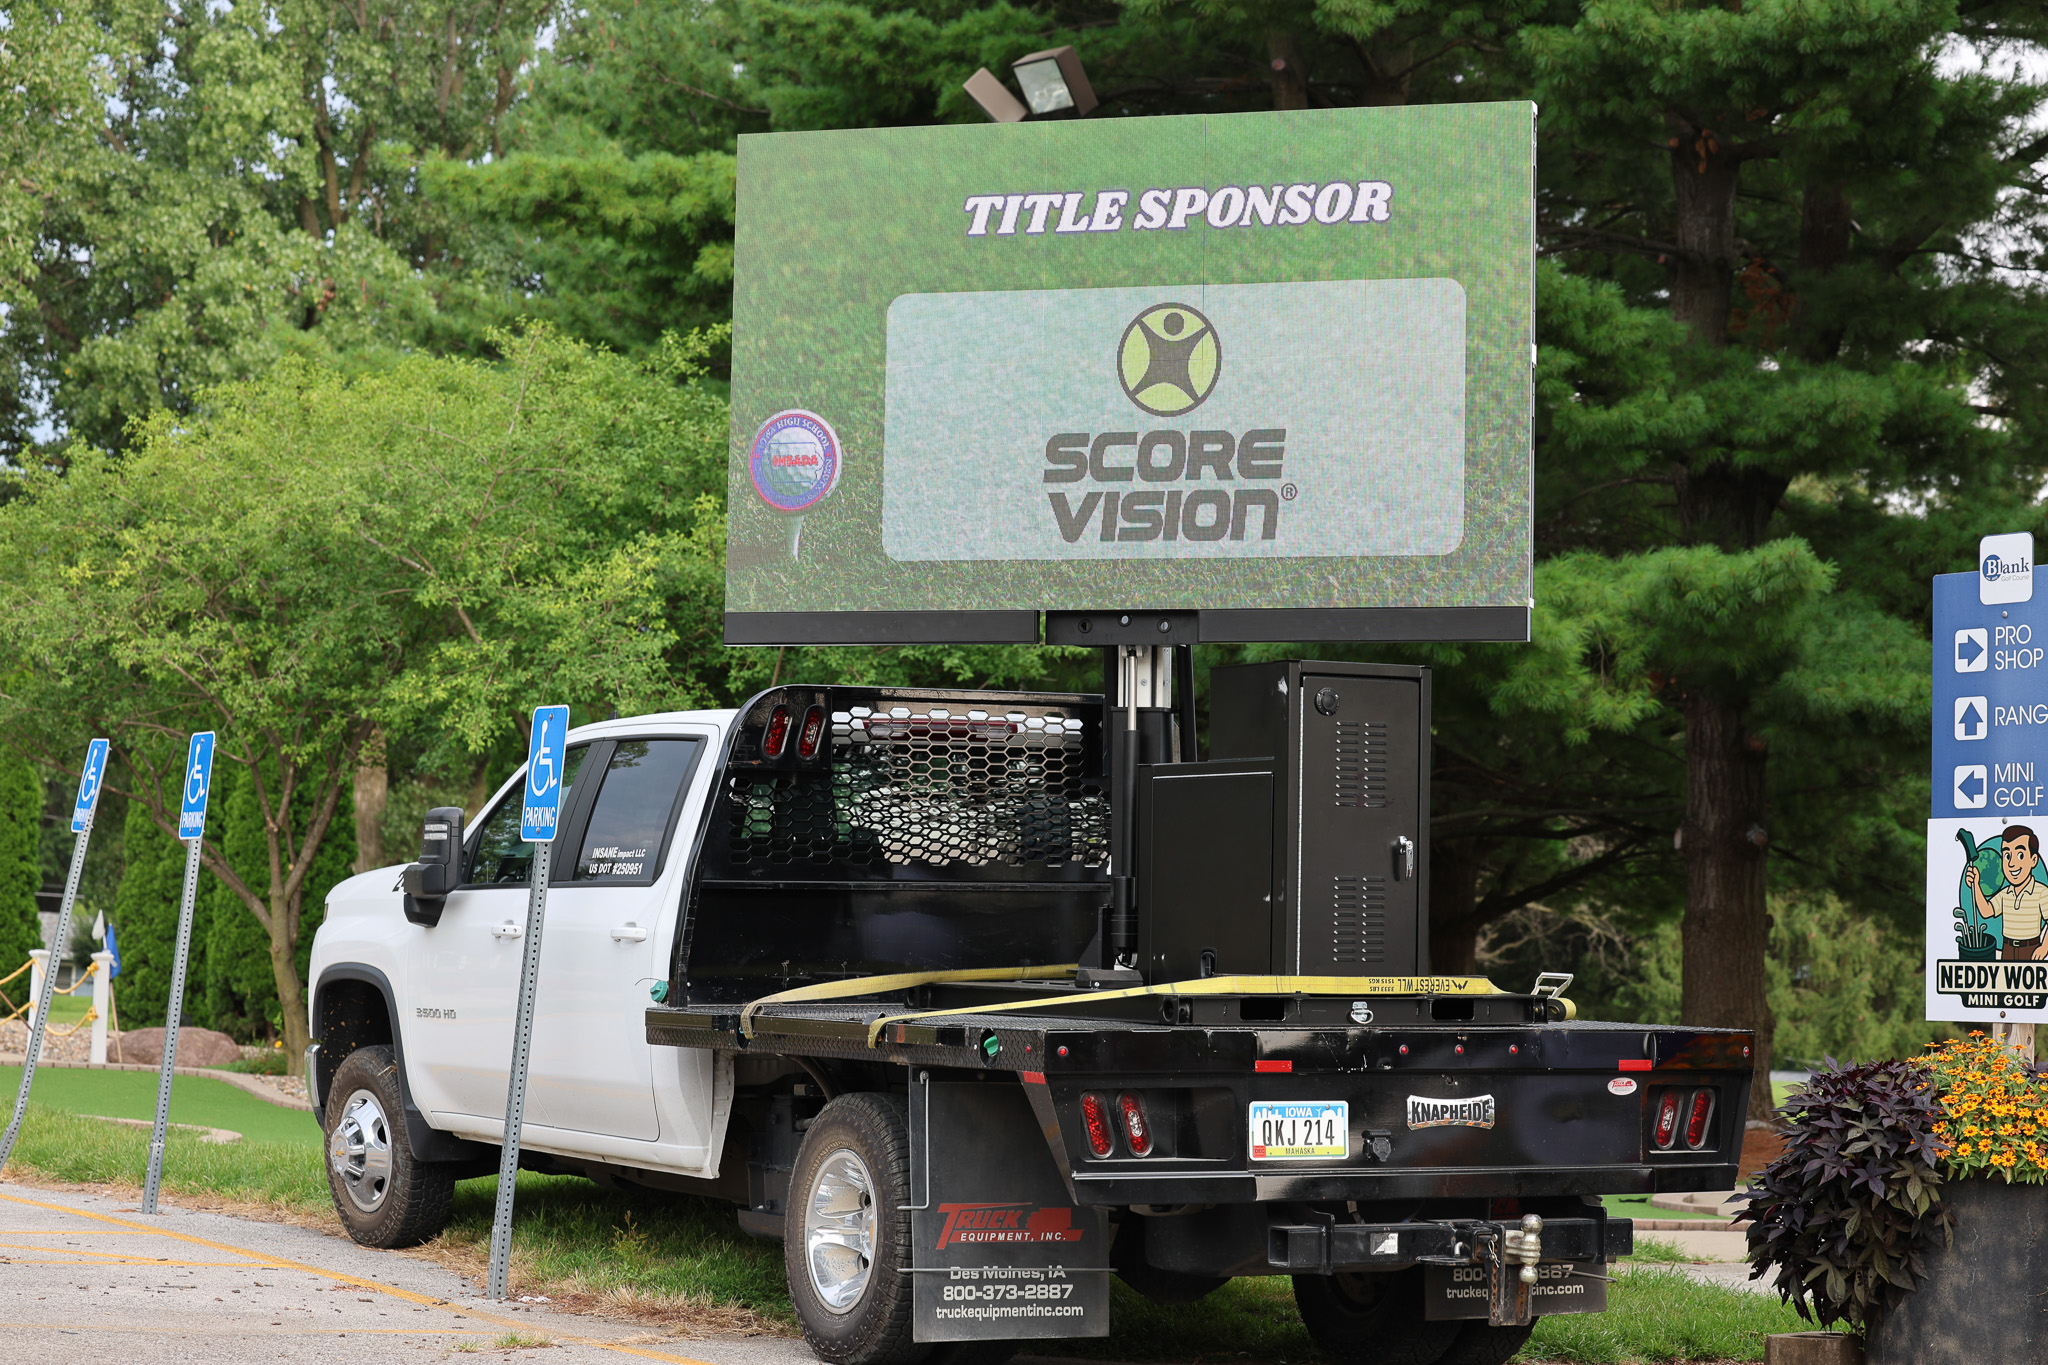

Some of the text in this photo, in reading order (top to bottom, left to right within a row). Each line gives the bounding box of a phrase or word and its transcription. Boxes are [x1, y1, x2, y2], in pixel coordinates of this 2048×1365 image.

[965, 181, 1393, 235] TITLE SPONSOR
[776, 417, 800, 429] HIGH
[802, 419, 830, 450] SCHOOL
[1043, 429, 1287, 483] SCORE
[1048, 488, 1280, 543] VISION
[1985, 556, 2030, 576] Blank
[1995, 624, 2032, 646] PRO
[1994, 648, 2044, 670] SHOP
[1994, 762, 2034, 783] MINI
[1994, 786, 2044, 809] GOLF
[181, 811, 204, 828] PARKING
[524, 806, 556, 828] PARKING
[592, 847, 646, 859] INSANE impact LLC
[589, 862, 643, 874] US DOT #250951
[1398, 979, 1449, 992] EVEREST WLL
[1941, 965, 2000, 989] NEDDY
[1967, 994, 2040, 1007] MINI GOLF
[416, 1007, 456, 1019] 3500 HD
[1285, 1107, 1313, 1118] IOWA
[1411, 1099, 1492, 1124] KNAPHEIDE
[1262, 1119, 1335, 1146] QKJ 214
[1285, 1147, 1315, 1155] MAHASKA
[936, 1202, 1032, 1250] TRUCK
[960, 1232, 1066, 1242] EQUIPMENT, INC.
[950, 1265, 1067, 1281] Des Moines, IA
[943, 1284, 1074, 1301] 800-373-2887
[936, 1304, 1084, 1321] truckequipmentinc.com
